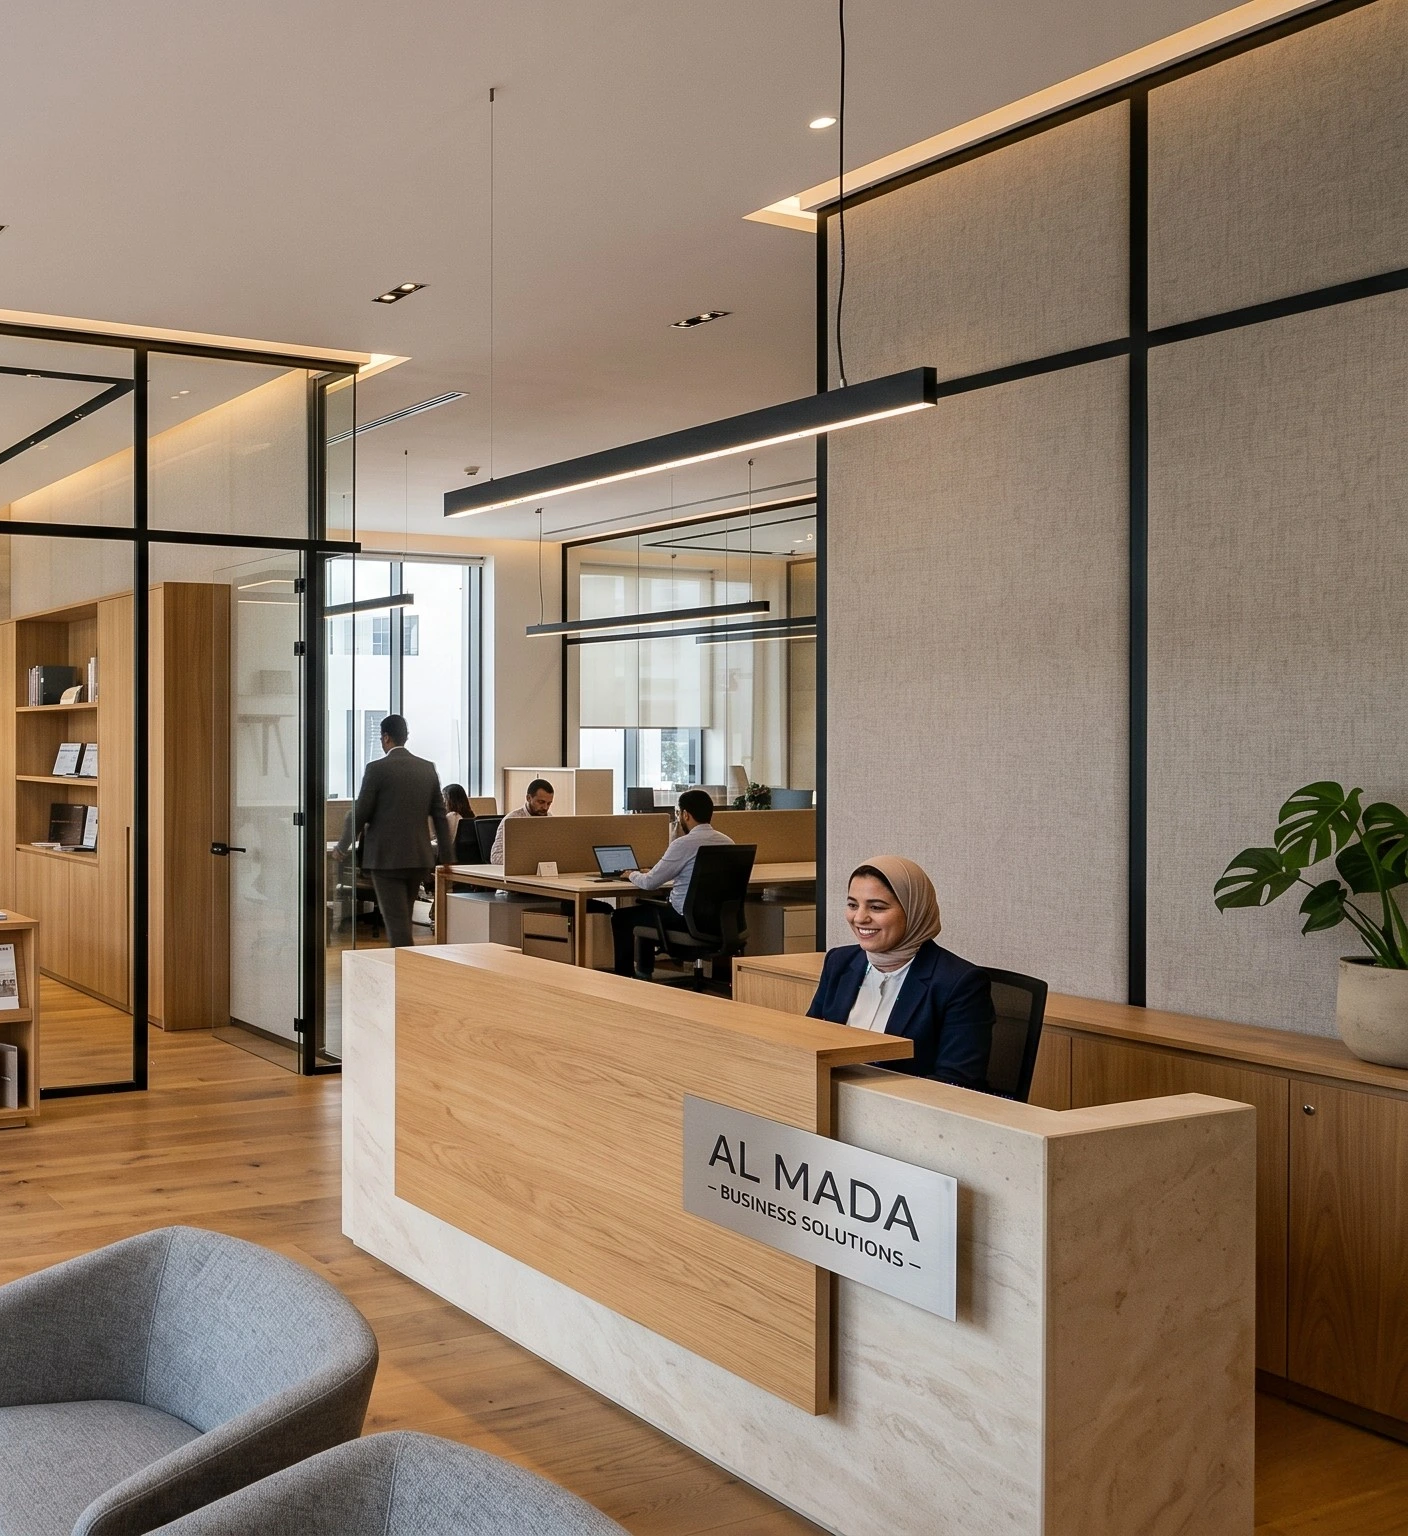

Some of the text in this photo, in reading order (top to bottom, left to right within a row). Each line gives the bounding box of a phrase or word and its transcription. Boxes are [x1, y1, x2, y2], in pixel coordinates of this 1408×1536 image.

[708, 1134, 921, 1243] AL MADA
[720, 1184, 797, 1226] BUSINESS
[801, 1216, 904, 1268] SOLUTIONS
